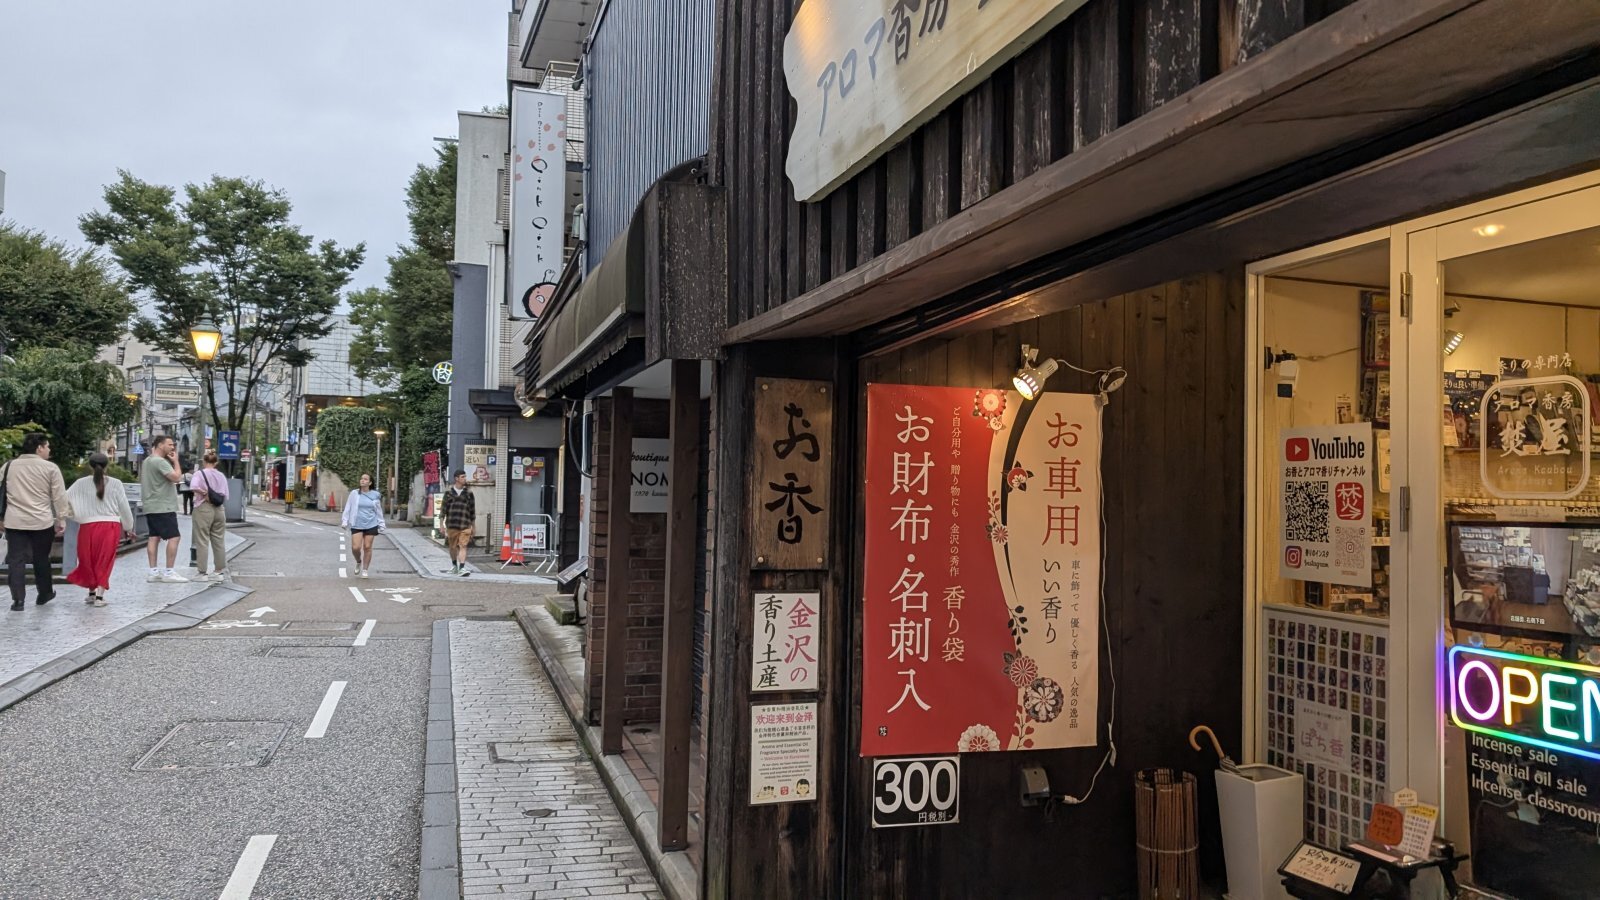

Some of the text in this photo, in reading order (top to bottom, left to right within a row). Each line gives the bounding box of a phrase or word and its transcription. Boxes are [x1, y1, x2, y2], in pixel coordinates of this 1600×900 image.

[631, 451, 669, 466] boutique
[764, 402, 824, 544] お香
[1311, 436, 1365, 460] YouTube
[887, 405, 936, 713] お財布・名刺入
[942, 406, 966, 662] ご自分用や 贈り物にも 金沢の秀作 香り袋
[1040, 412, 1082, 644] お車用 いい香り
[756, 595, 783, 688] 香り土産
[784, 597, 818, 682] 金沢の
[1069, 559, 1081, 729] 車に飾って 優しく香る 人気の逸品
[875, 761, 957, 814] 300
[1471, 753, 1587, 797] Essential oil sale
[1472, 732, 1558, 766] Incense sale
[1471, 773, 1600, 824] Incense classroom
